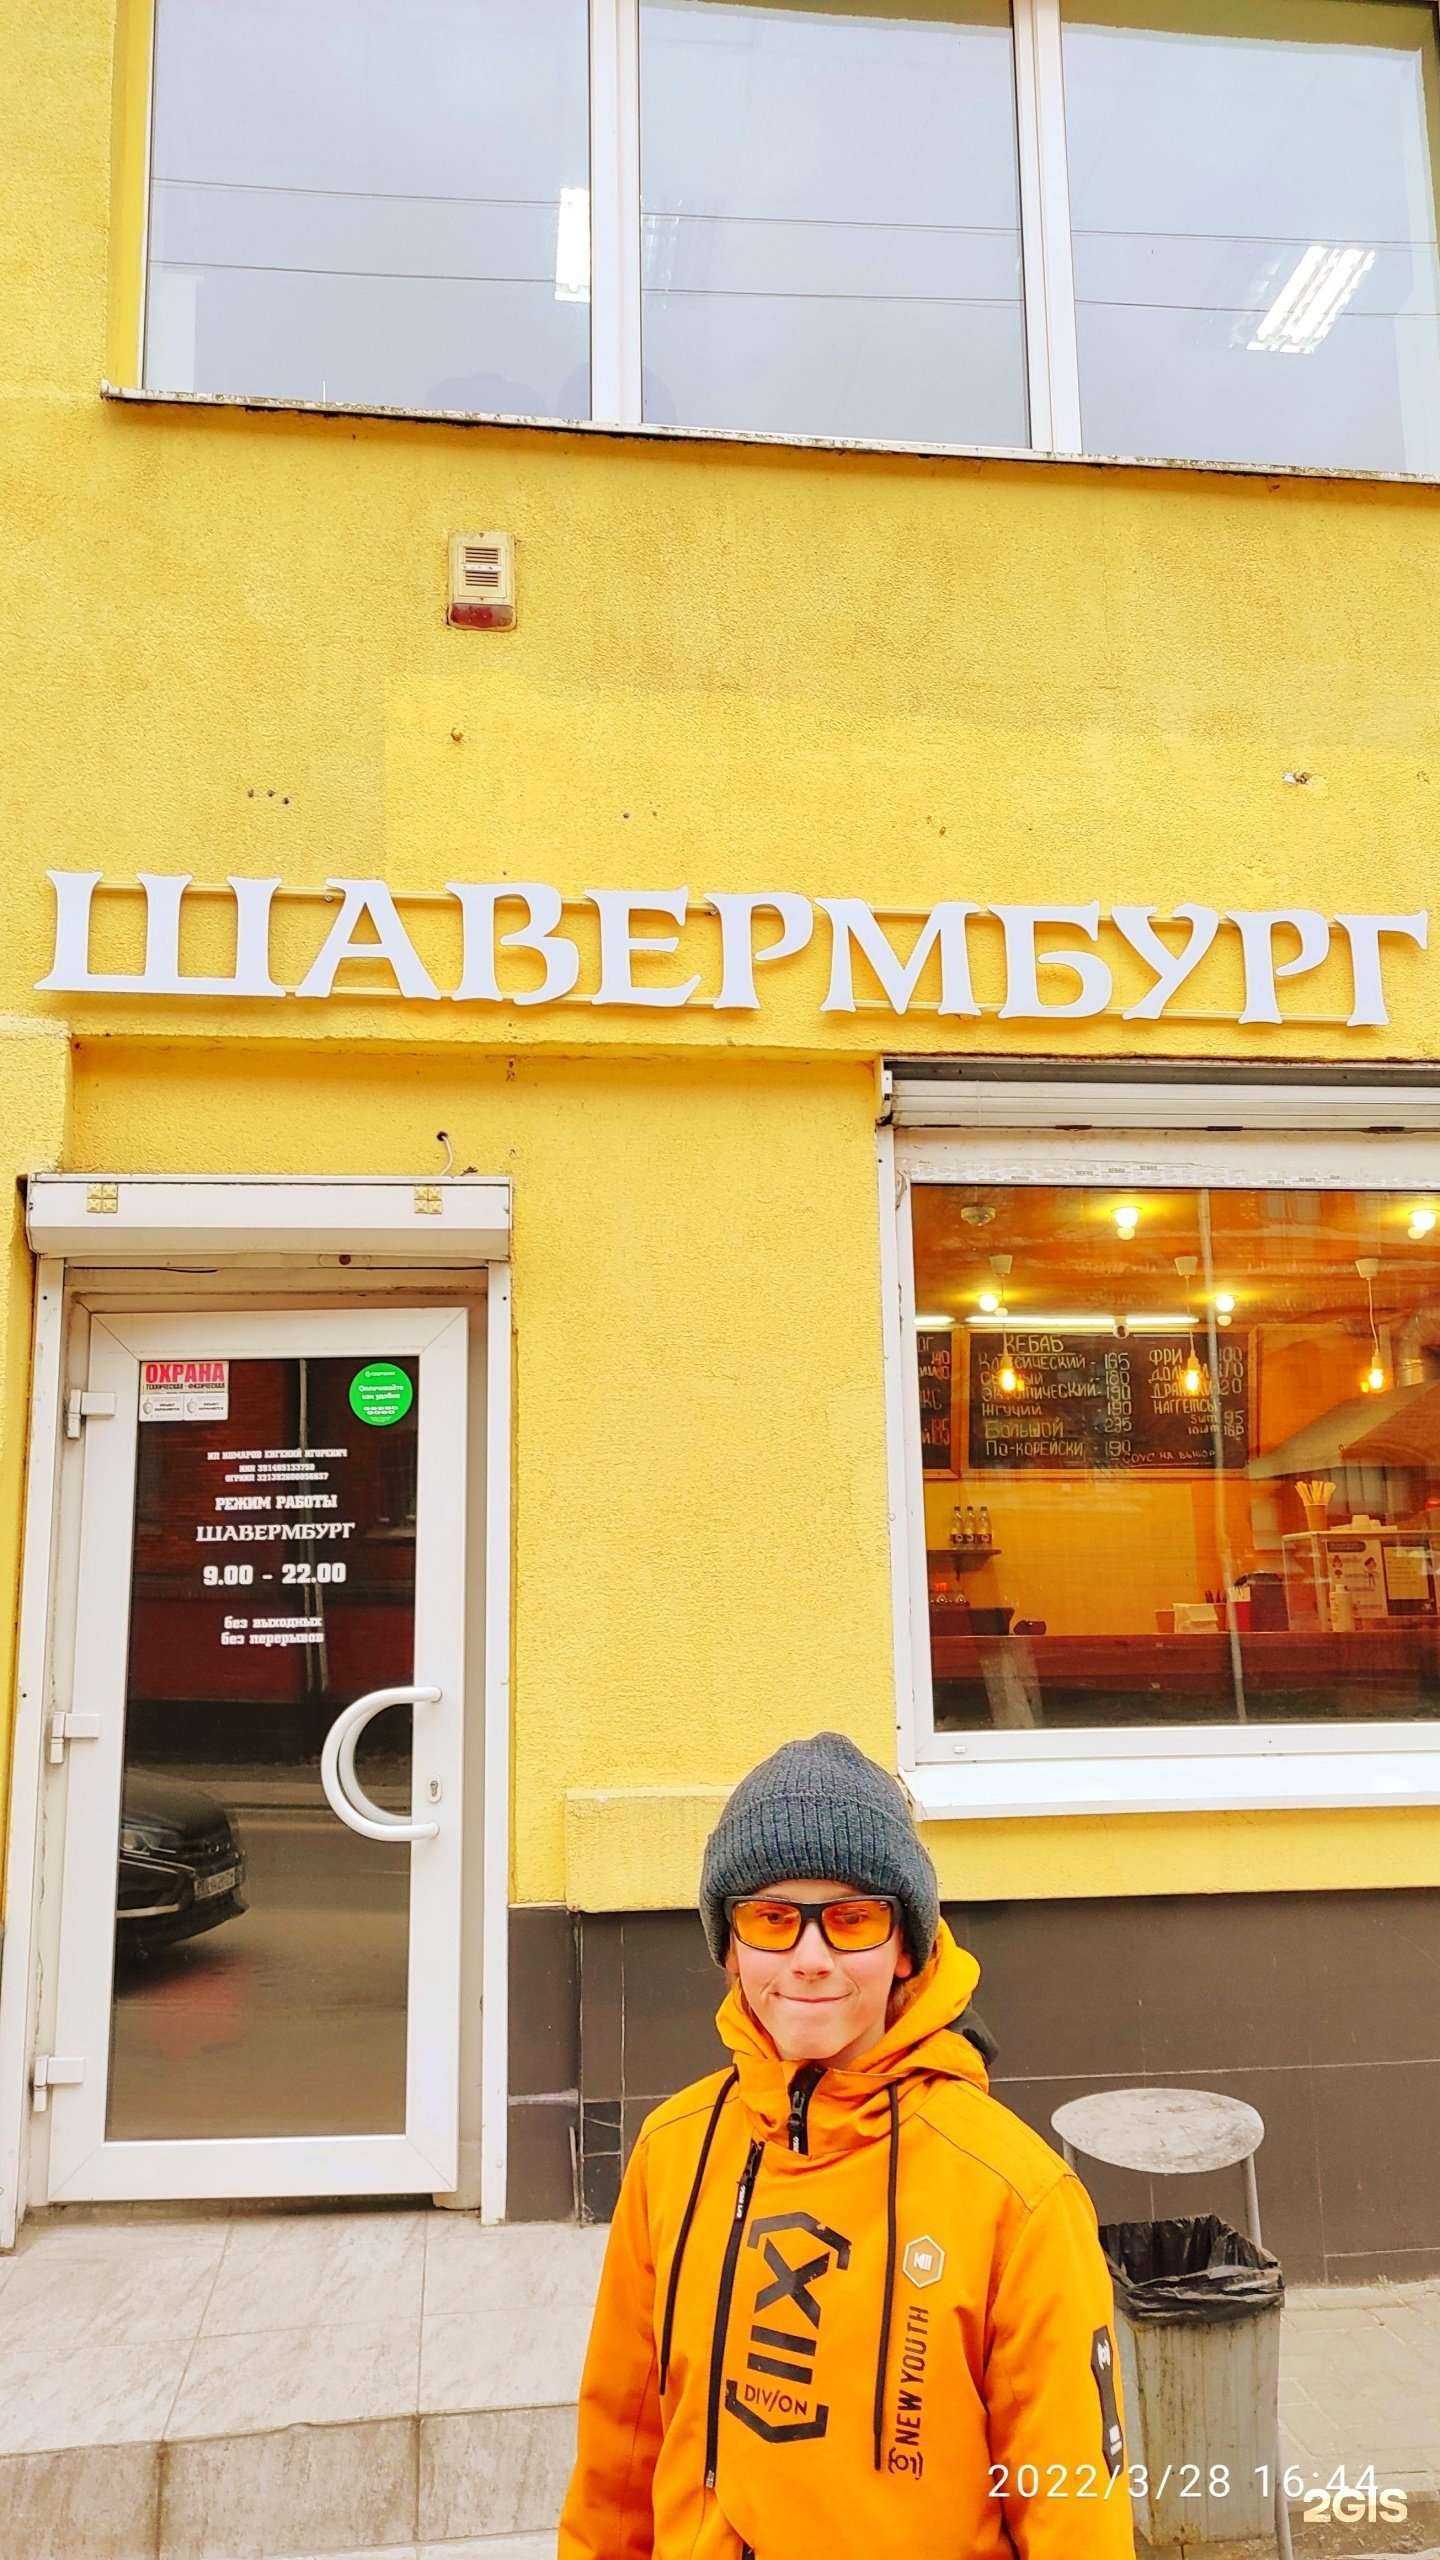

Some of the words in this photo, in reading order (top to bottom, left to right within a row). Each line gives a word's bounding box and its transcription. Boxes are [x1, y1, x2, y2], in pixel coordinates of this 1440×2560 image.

[34, 869, 1428, 1028] ШАВЕРМБУРГ
[1004, 1335, 1064, 1353] КЕБАБ
[1104, 1353, 1130, 1370] 165
[1149, 1348, 1182, 1365] ФРИ
[145, 1362, 225, 1383] ОХРАНА
[215, 1496, 272, 1511] РЕЖИМ
[275, 1494, 338, 1509] РАБОТЫ
[196, 1522, 355, 1541] ШАВЕРМБУРГ
[203, 1564, 254, 1586] 9.00
[281, 1562, 347, 1584] 22.00
[224, 1615, 248, 1629] без
[252, 1616, 323, 1629] выходных
[220, 1632, 246, 1645] без
[249, 1632, 325, 1647] перерывов
[900, 2305, 929, 2392] YOUTH
[894, 2389, 923, 2446] NEW
